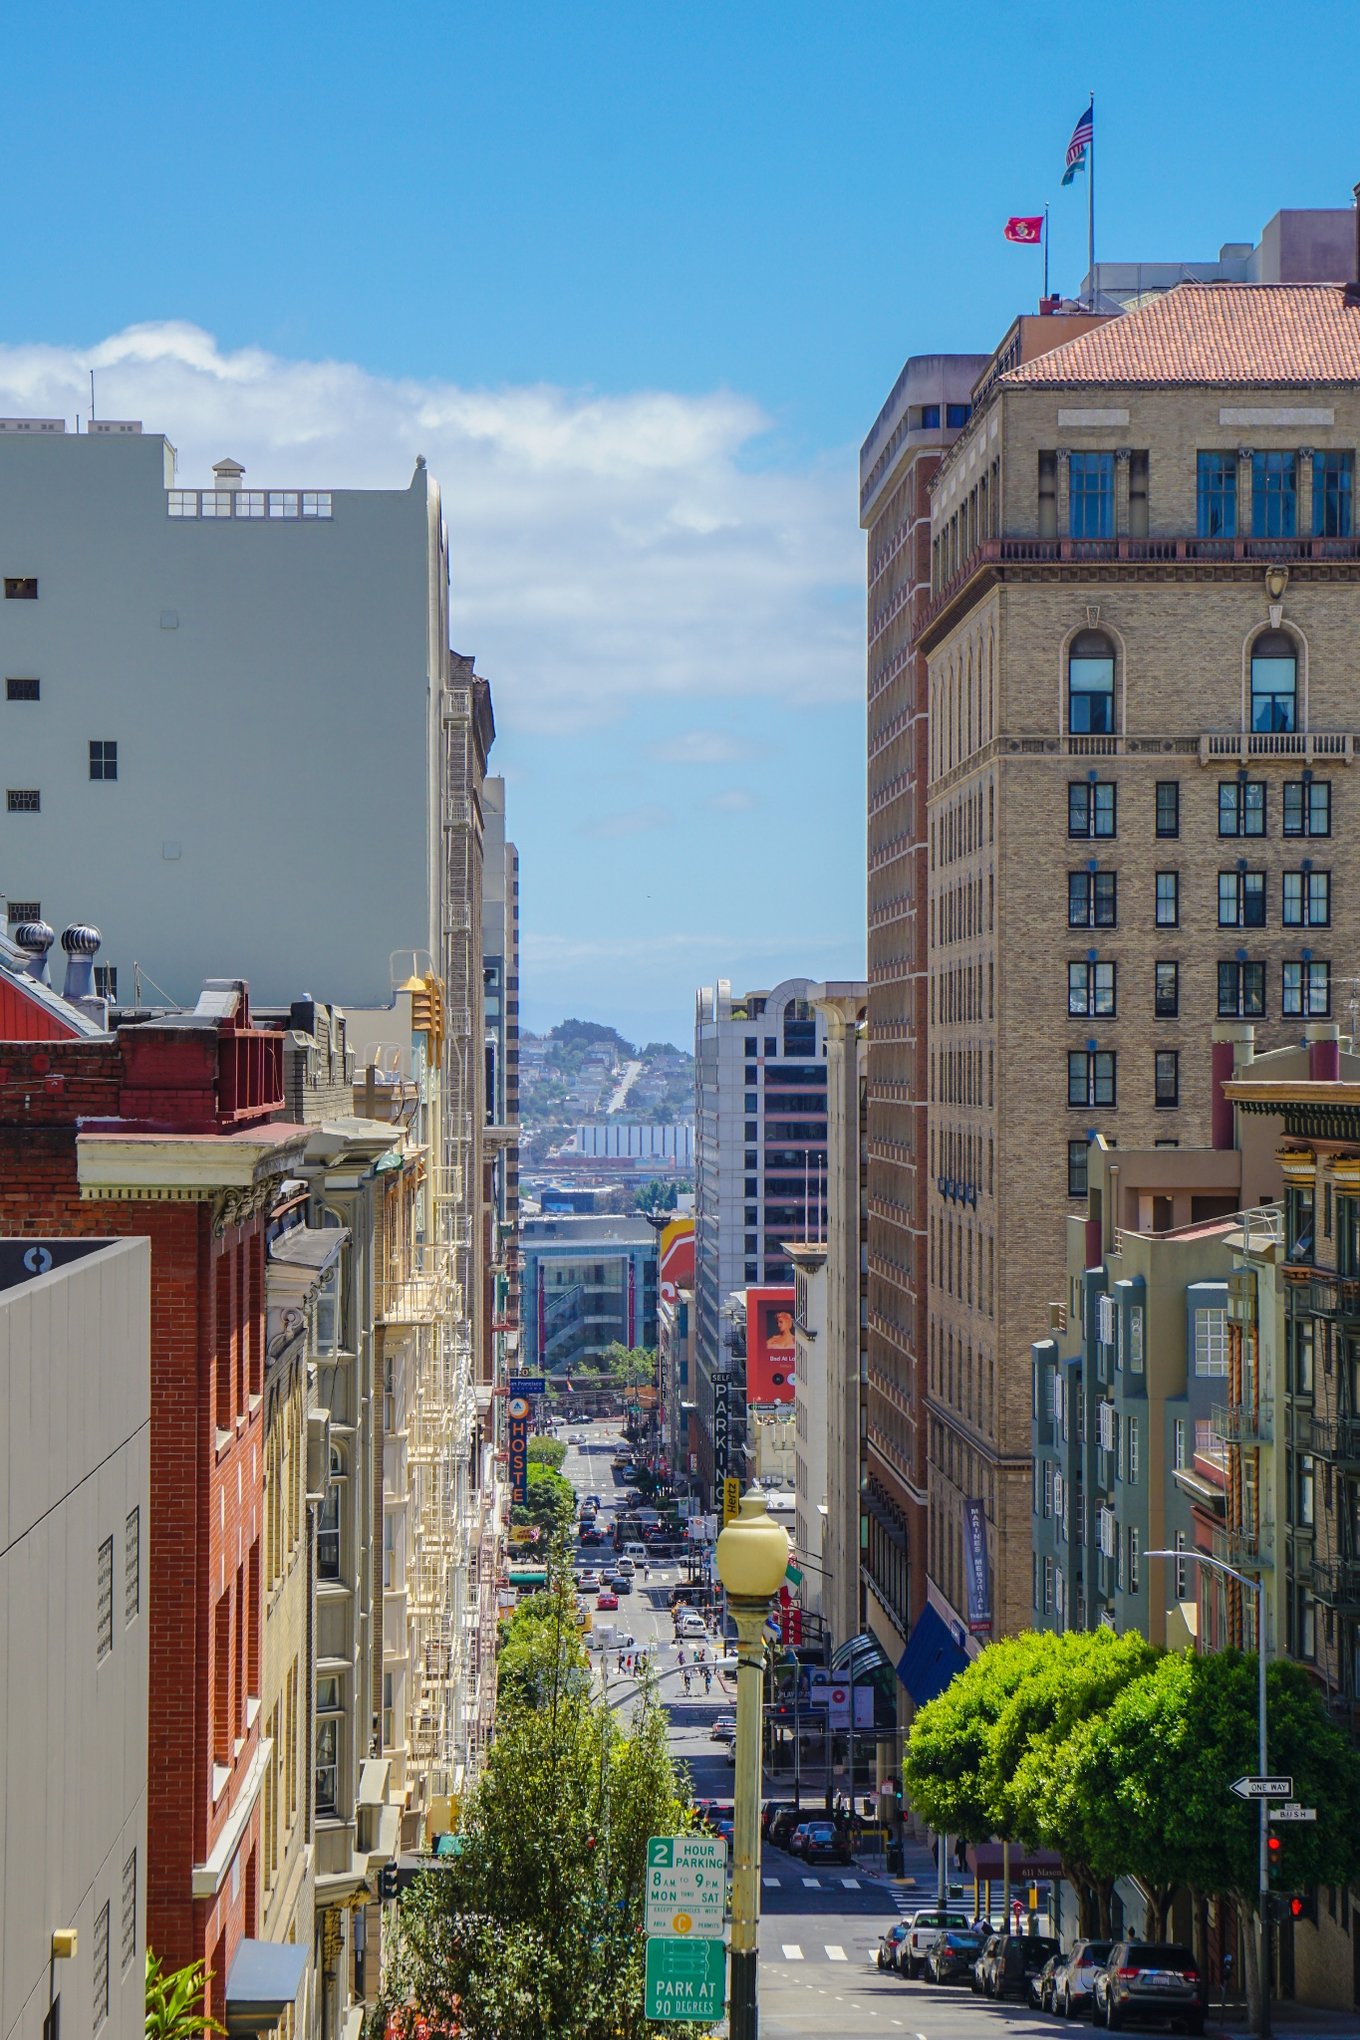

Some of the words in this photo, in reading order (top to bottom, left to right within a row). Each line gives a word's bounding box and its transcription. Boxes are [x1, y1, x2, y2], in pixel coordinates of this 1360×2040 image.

[712, 1374, 730, 1382] SELF
[715, 1384, 727, 1501] PARKING
[511, 1422, 525, 1502] HOSTE
[727, 1482, 737, 1514] Hertz
[970, 1508, 982, 1553] MARINES
[974, 1559, 984, 1611] MEMORIAL
[1251, 1783, 1267, 1792] ONE
[1270, 1783, 1288, 1792] WAY
[653, 1844, 669, 1864] 2
[684, 1845, 715, 1857] HOUR
[676, 1858, 723, 1869] PARKING
[653, 1871, 662, 1887] 8
[695, 1873, 704, 1888] 9
[1022, 1869, 1034, 1877] 611
[651, 1891, 677, 1902] MON
[701, 1893, 719, 1904] SAT
[678, 1915, 687, 1932] C
[656, 1980, 694, 1997] PARK
[698, 1982, 716, 1998] AT
[655, 2000, 671, 2016] 90
[675, 2001, 714, 2013] DEGREES
